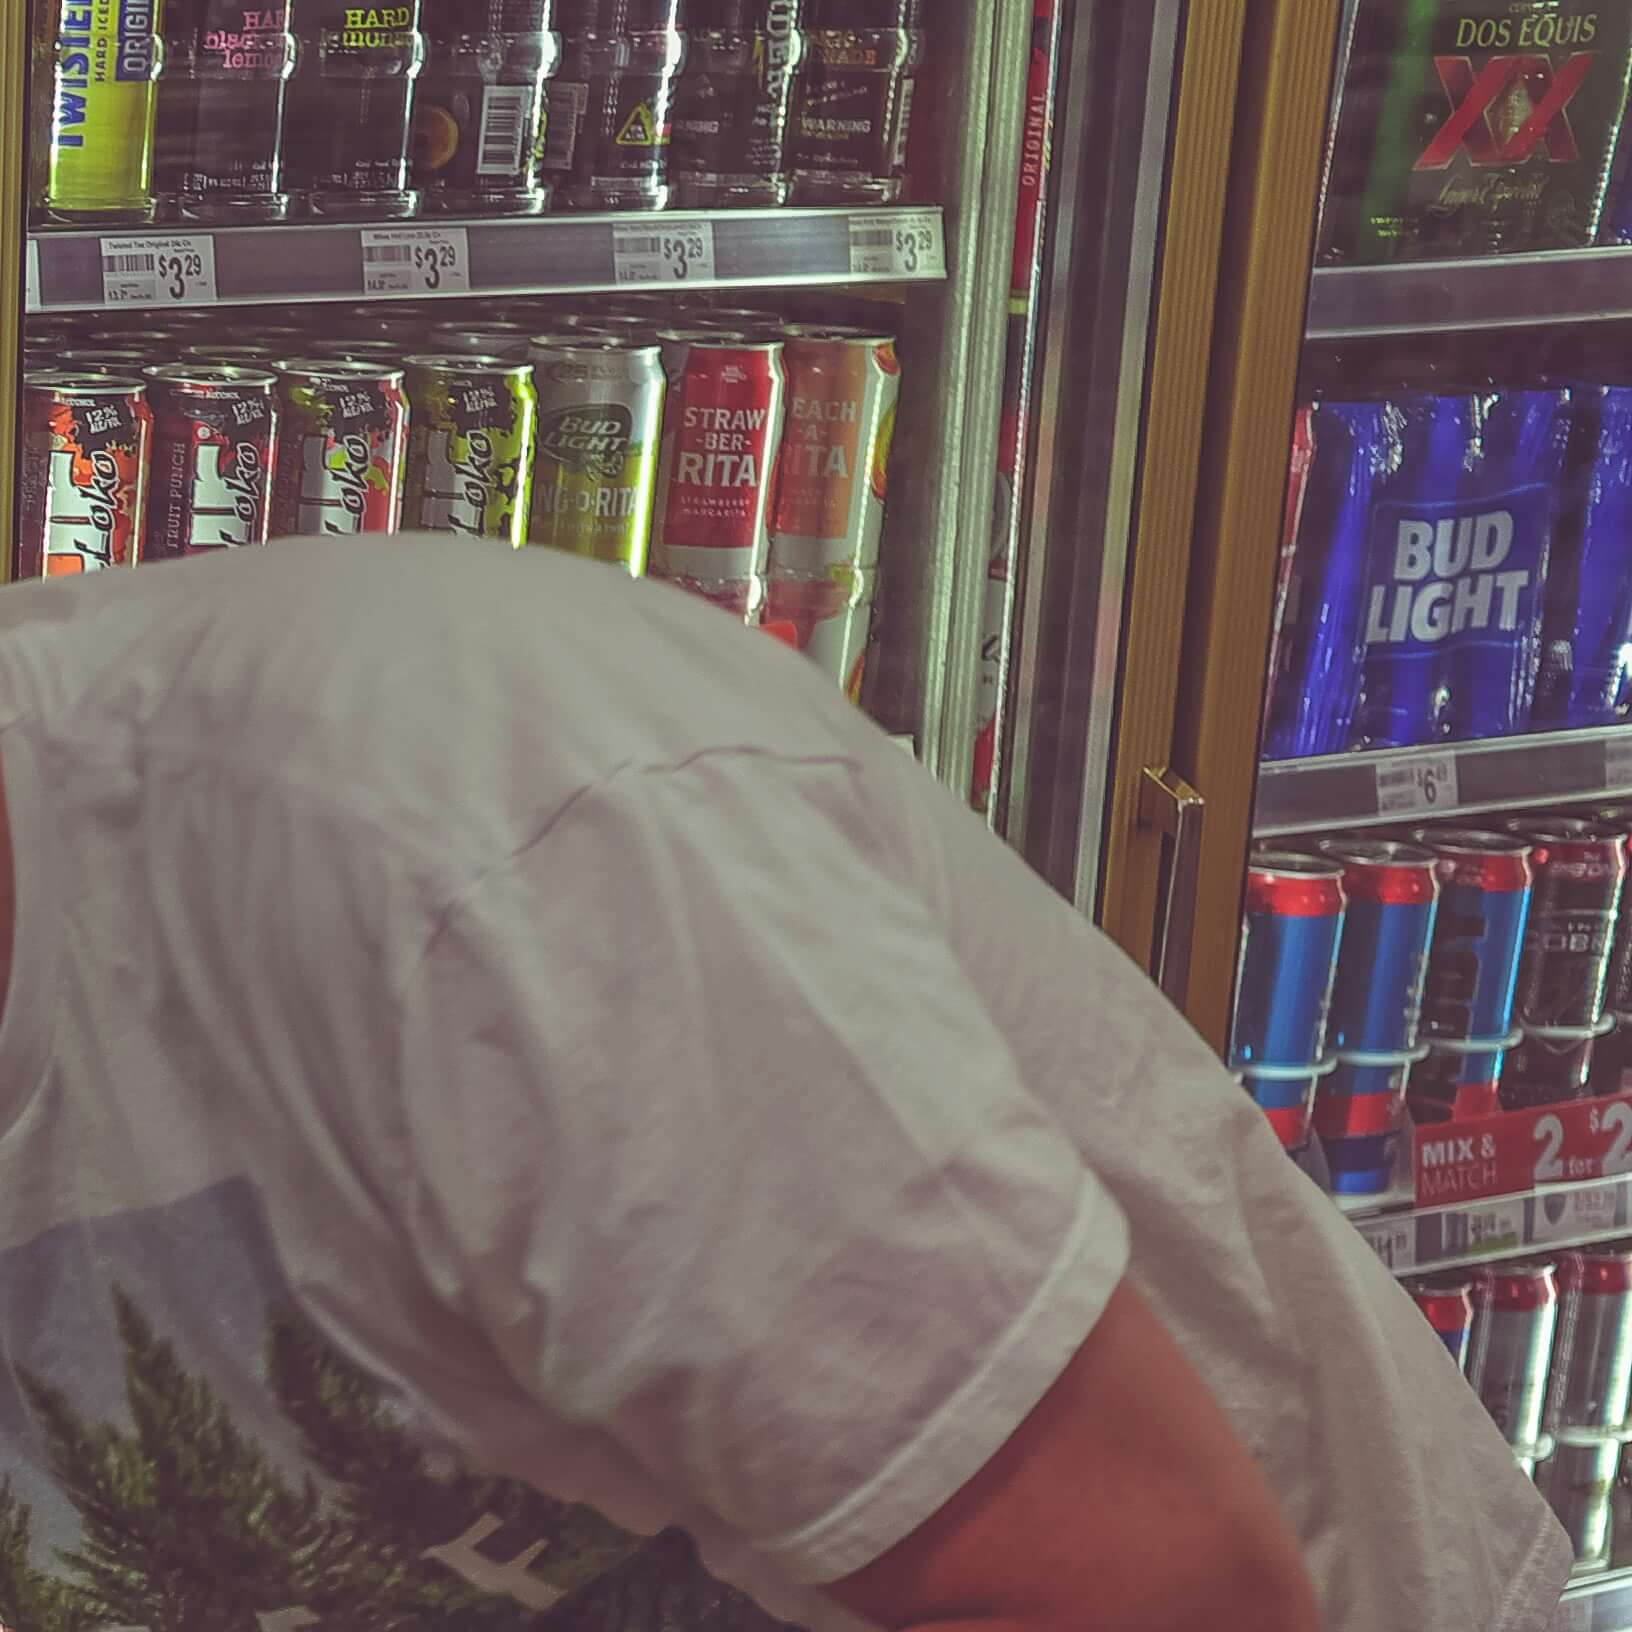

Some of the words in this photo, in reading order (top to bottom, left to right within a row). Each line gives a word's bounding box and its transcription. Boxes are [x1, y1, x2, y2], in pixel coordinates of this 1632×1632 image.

[344, 7, 410, 28] HARD
[1456, 18, 1511, 48] DOS
[1518, 14, 1597, 47] EQUIS
[94, 33, 106, 81] HARD
[801, 118, 872, 133] WARNING
[1412, 52, 1594, 171] XX
[559, 417, 622, 434] BUD
[683, 407, 766, 431] STRAW
[545, 433, 628, 451] LIGHT
[677, 454, 760, 487] RITA
[1393, 510, 1514, 581] BUD
[1366, 570, 1530, 644] LIGHT
[1422, 1141, 1471, 1166] MIX
[1481, 1135, 1496, 1157] &
[1534, 1114, 1563, 1178] 2
[1421, 1161, 1497, 1194] MATCH
